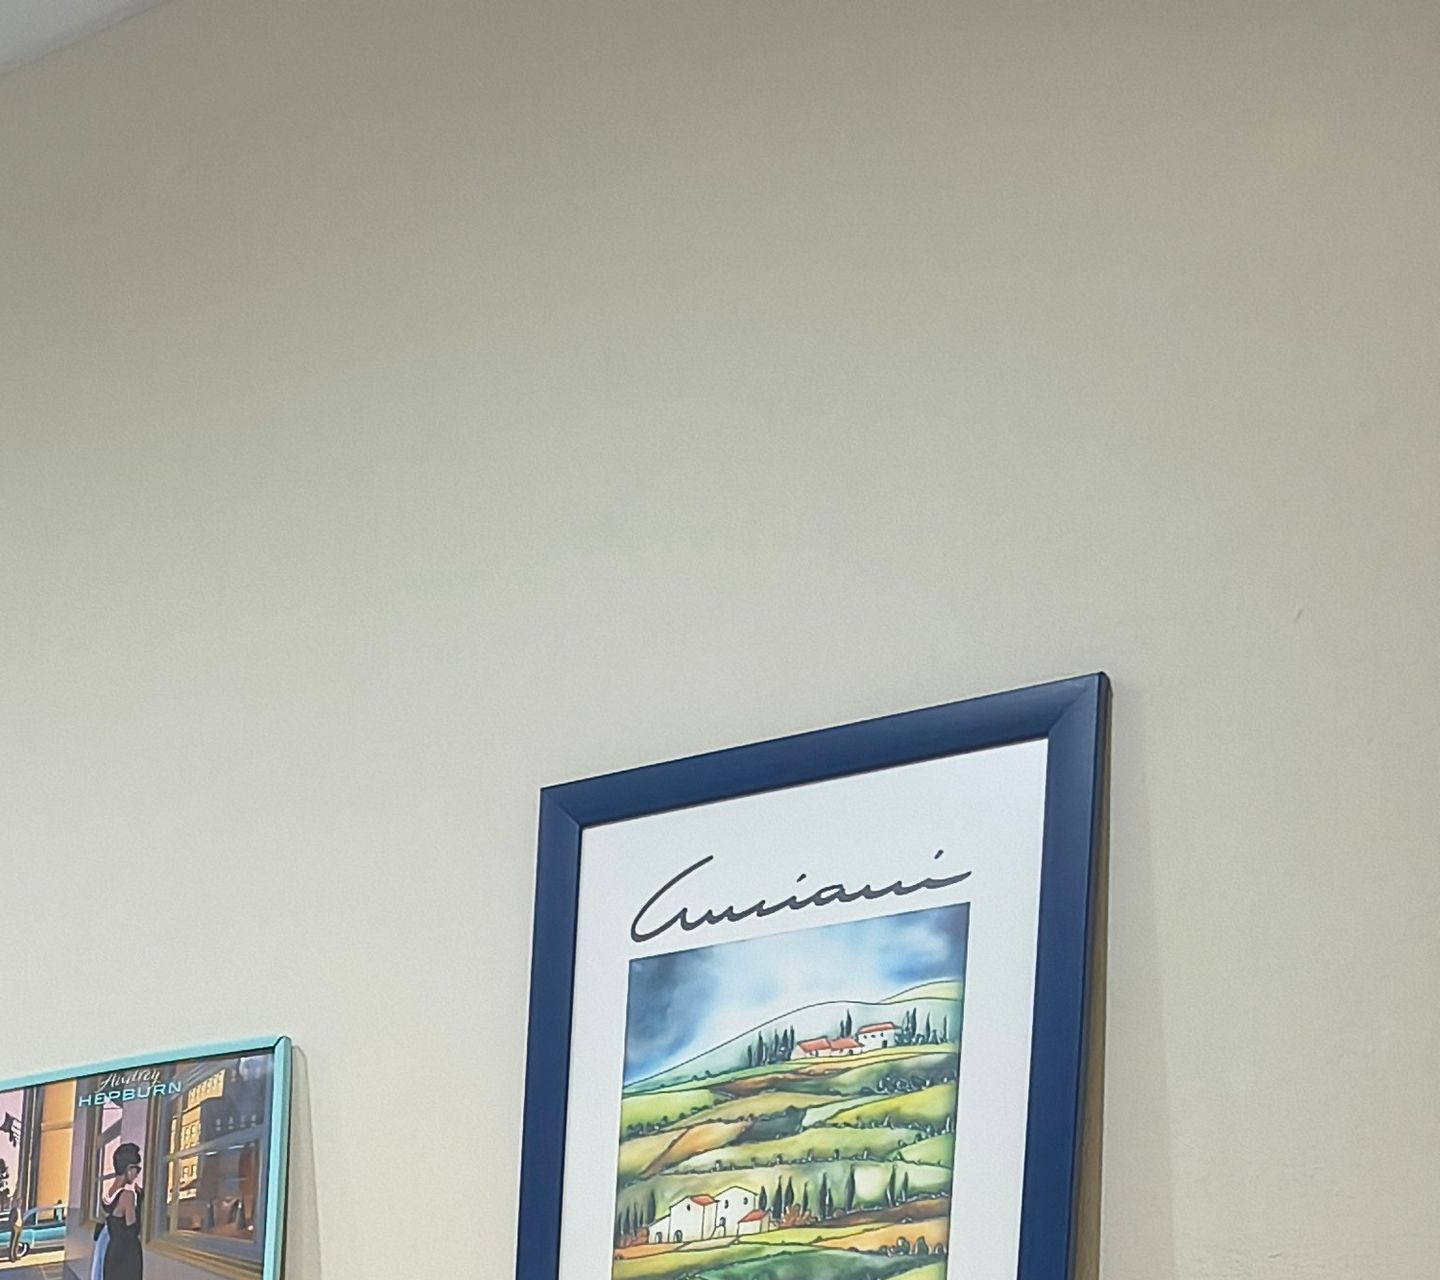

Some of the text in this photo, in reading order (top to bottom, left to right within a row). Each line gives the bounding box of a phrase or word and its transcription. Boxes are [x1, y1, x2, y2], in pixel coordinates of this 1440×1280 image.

[631, 850, 972, 943] Cruciani
[95, 1068, 161, 1093] Audrey
[78, 1081, 182, 1107] HEPBURN
